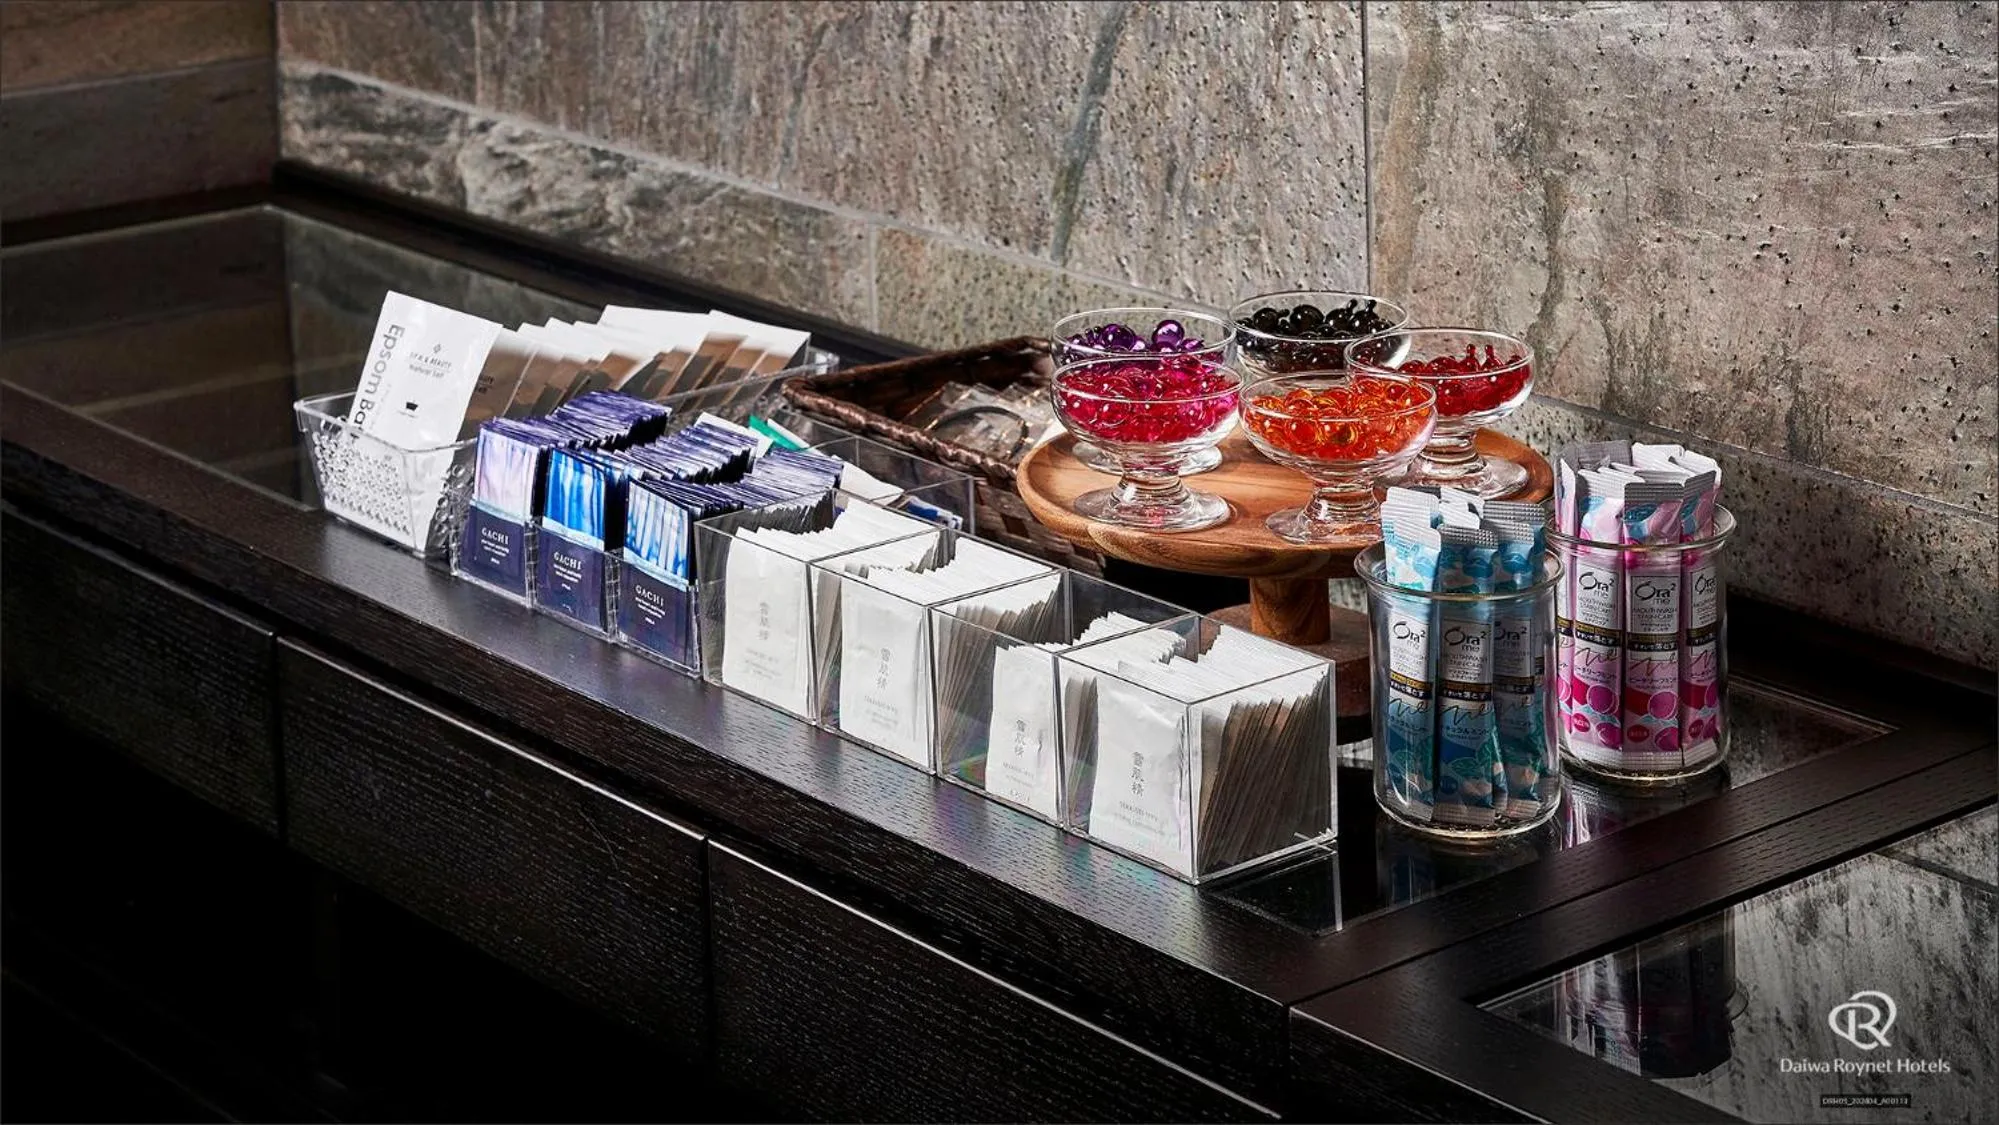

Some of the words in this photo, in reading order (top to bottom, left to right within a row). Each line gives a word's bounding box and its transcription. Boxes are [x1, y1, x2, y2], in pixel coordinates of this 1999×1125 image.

[365, 324, 405, 394] Epsom
[481, 527, 509, 545] GACHI
[553, 551, 582, 570] GACHI
[635, 584, 664, 607] GACHI
